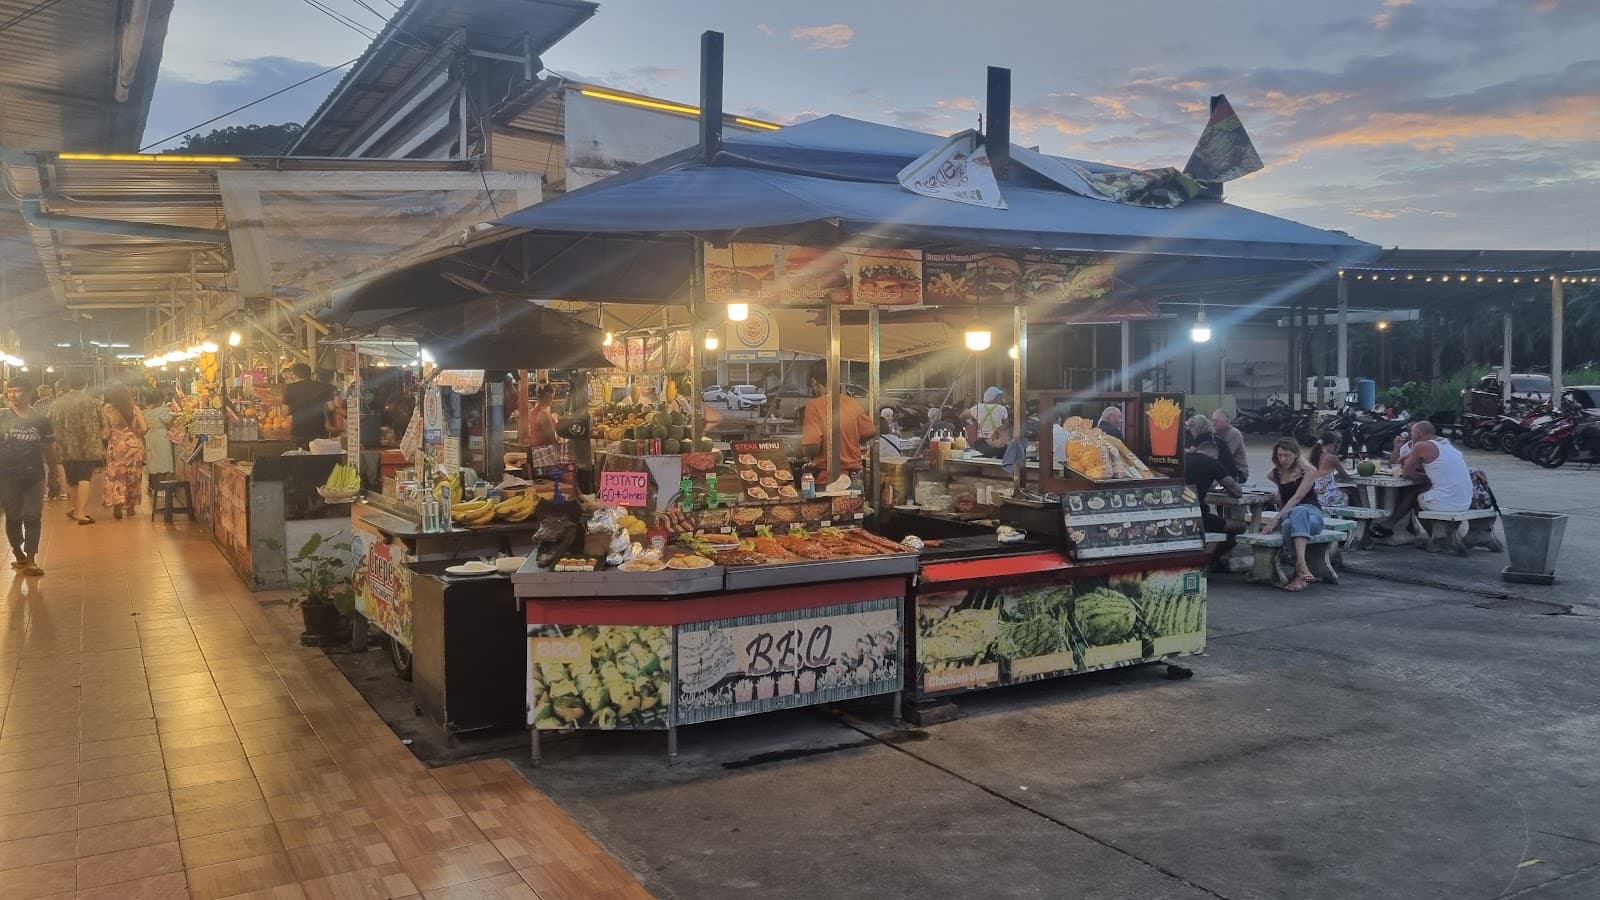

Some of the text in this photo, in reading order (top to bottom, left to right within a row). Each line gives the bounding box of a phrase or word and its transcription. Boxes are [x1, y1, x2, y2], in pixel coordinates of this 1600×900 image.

[735, 441, 780, 451] STEAK MENU
[605, 474, 646, 488] POTATO
[369, 543, 394, 586] Crepe
[536, 640, 581, 660] BBQ
